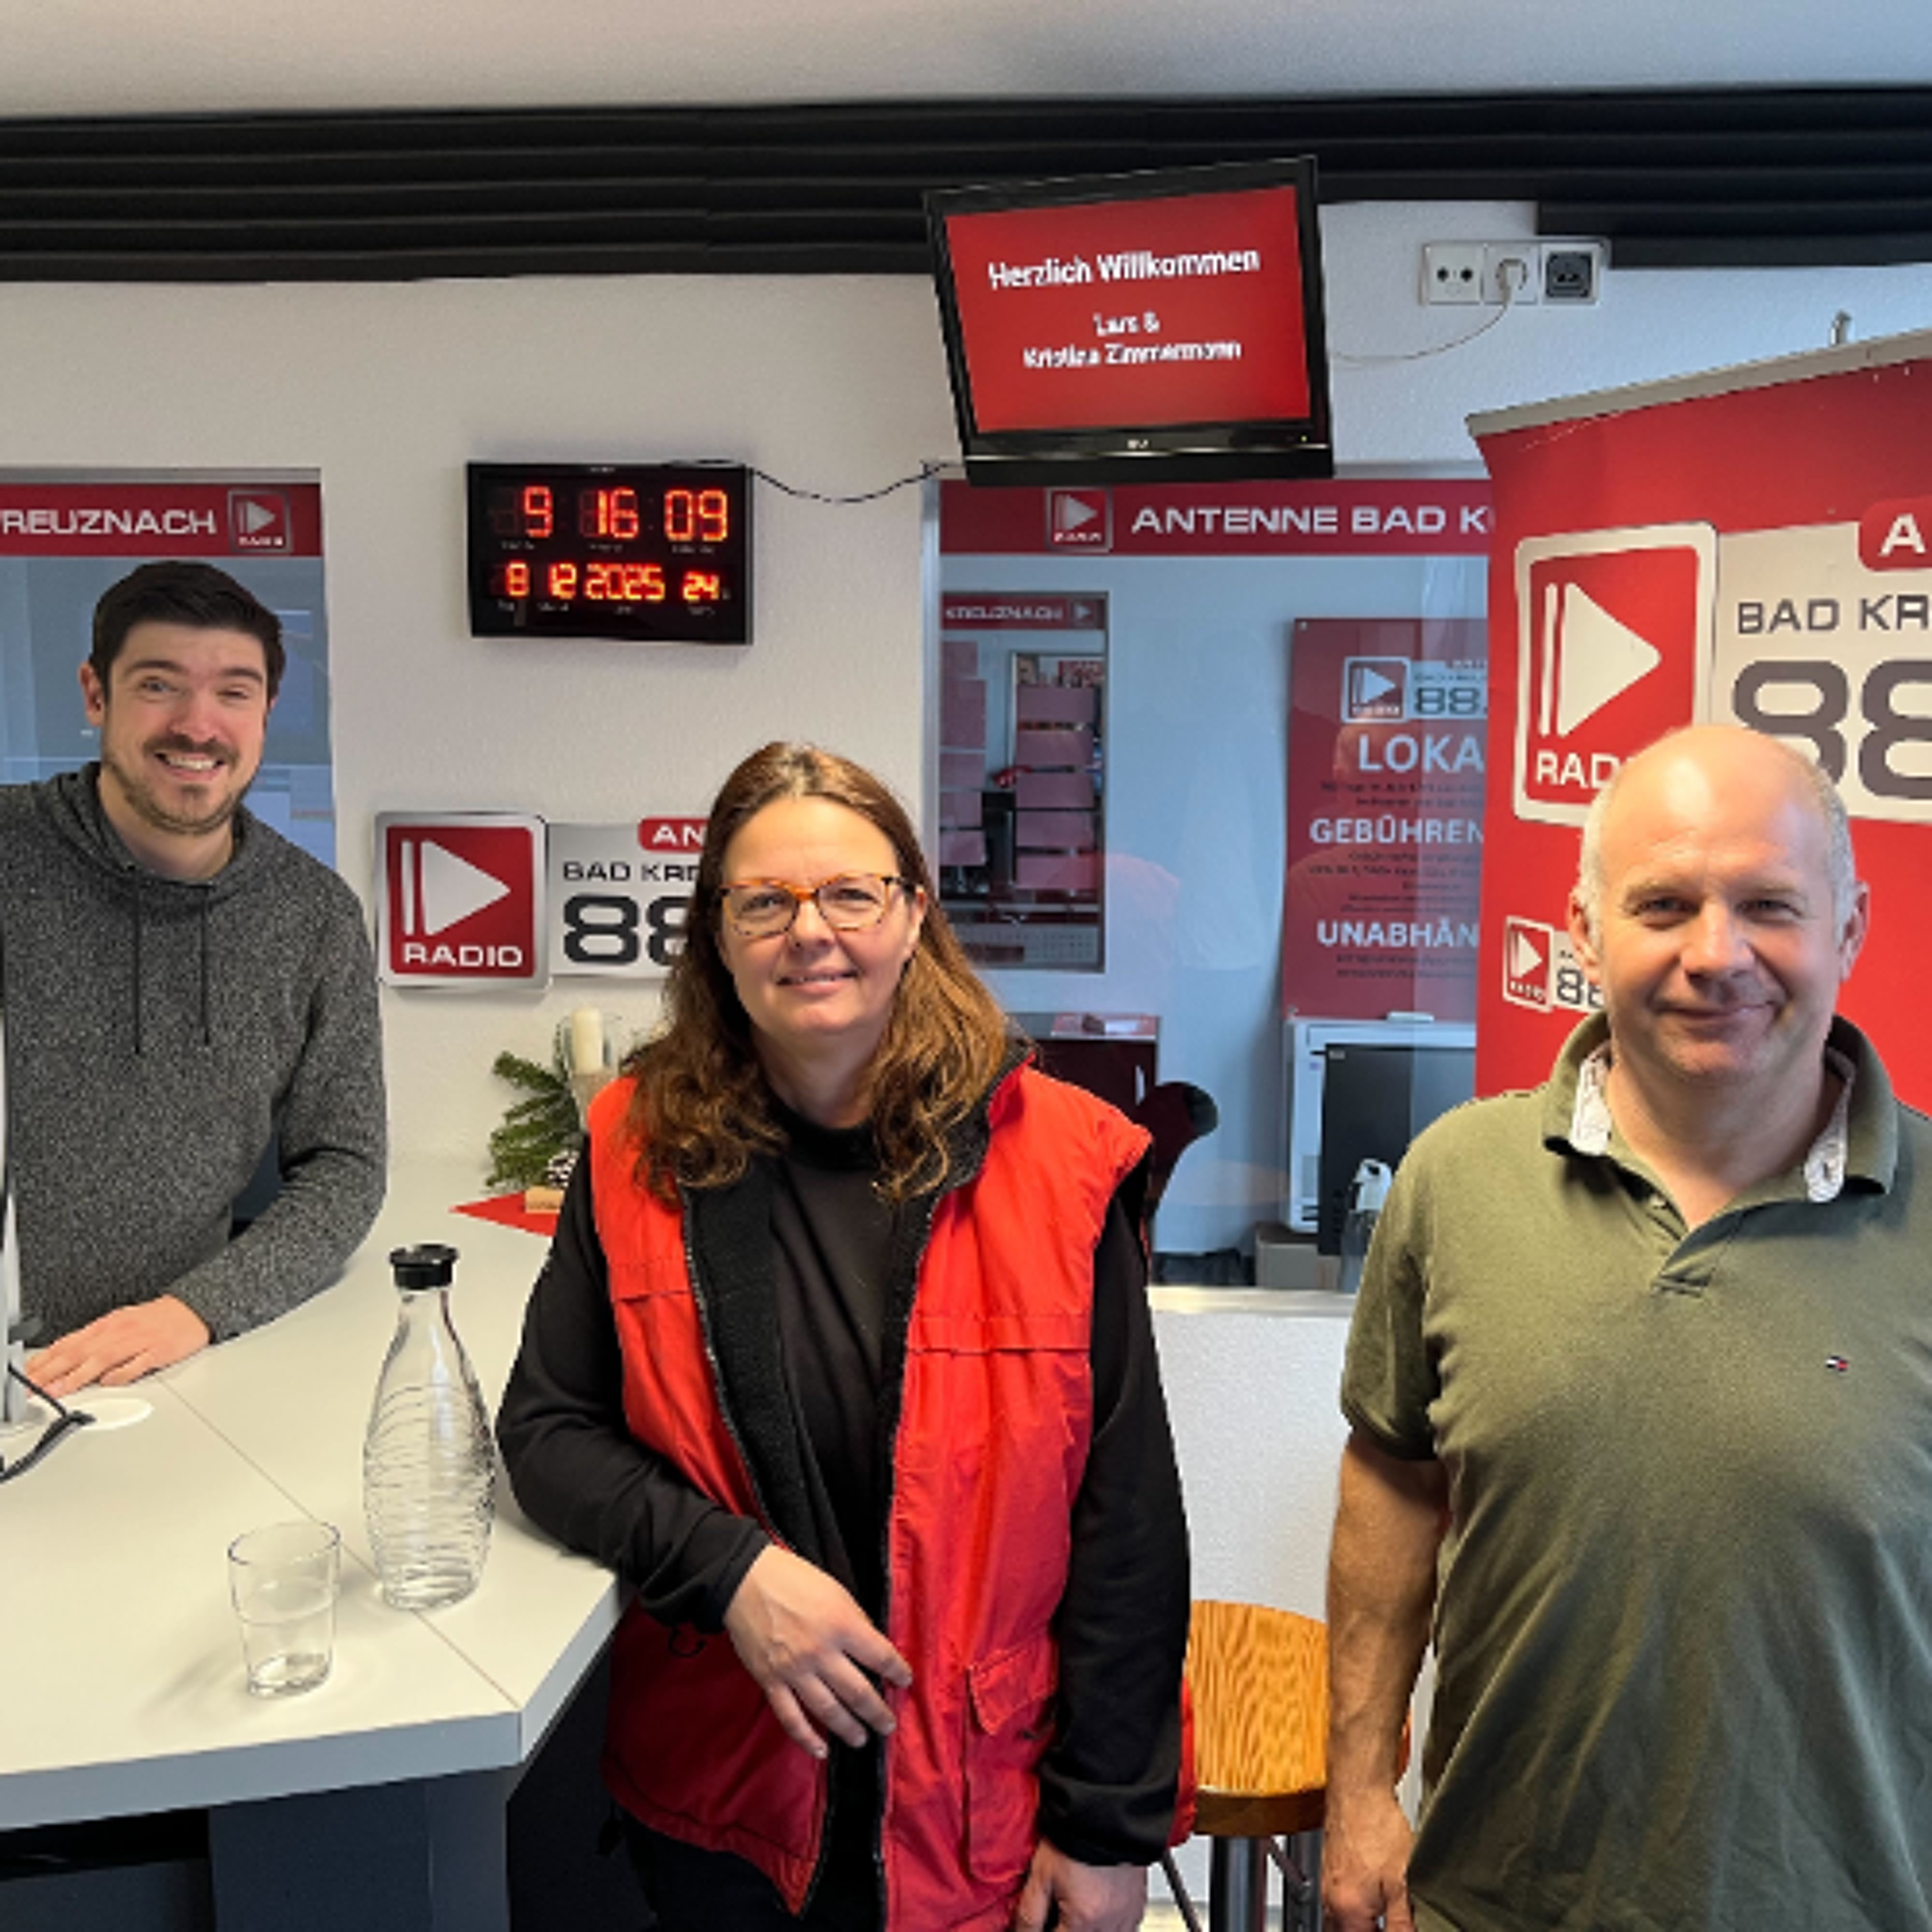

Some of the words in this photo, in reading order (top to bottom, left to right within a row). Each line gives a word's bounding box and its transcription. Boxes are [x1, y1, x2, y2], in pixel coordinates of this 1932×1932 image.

[988, 255, 1092, 290] Herzlich
[1097, 250, 1260, 282] Willkommen
[1094, 313, 1138, 336] Lars
[1144, 312, 1160, 332] &
[1023, 344, 1100, 368] Kristina
[1104, 341, 1240, 365] Zimmermann
[0, 509, 216, 535] REUZNACH
[524, 486, 553, 538] 9
[598, 488, 639, 539] 16
[665, 489, 727, 542] 09
[1132, 507, 1338, 534] ANTENNE
[1351, 507, 1447, 534] BAD
[1459, 506, 1492, 534] K
[506, 562, 529, 596] 8
[585, 564, 665, 601] 2025
[682, 571, 719, 600] 24
[1738, 599, 1839, 634] BAD
[1859, 594, 1929, 630] KR
[1359, 734, 1484, 772] LOKA
[1536, 750, 1629, 790] RAD
[652, 824, 705, 847] AN
[564, 861, 630, 882] BAD
[404, 943, 523, 967] RADIO
